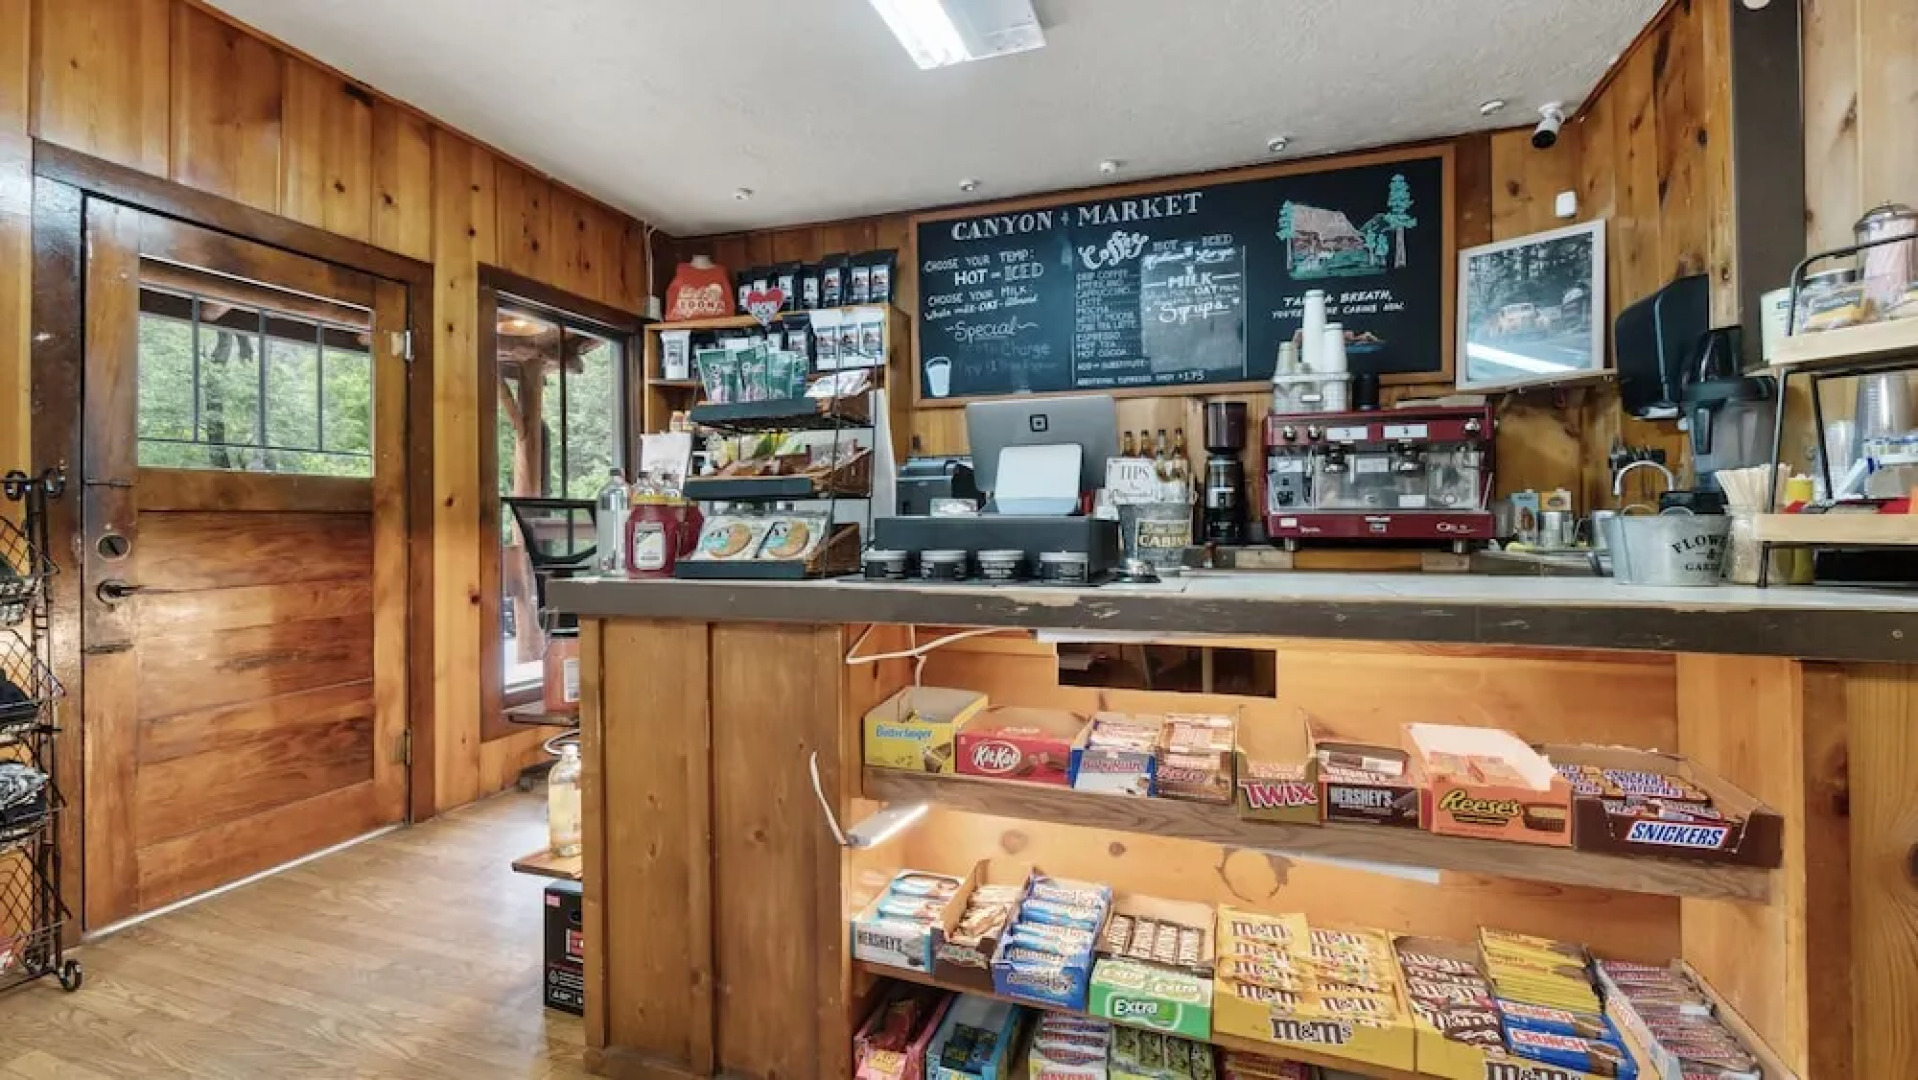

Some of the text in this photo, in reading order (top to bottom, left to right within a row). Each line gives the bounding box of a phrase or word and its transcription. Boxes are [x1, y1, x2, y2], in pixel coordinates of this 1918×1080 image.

[951, 191, 1203, 241] CANYON MARKET
[923, 257, 960, 273] CHOOSE
[964, 254, 991, 267] YOUR
[954, 262, 1045, 287] HOT ICED
[1168, 271, 1213, 289] MILK
[927, 292, 964, 307] CHOOSE
[968, 289, 994, 301] YOUR
[1330, 786, 1394, 807] HERSHEY'S
[1440, 787, 1521, 817] Reese's
[1631, 821, 1724, 847] SNICKERS
[1114, 998, 1158, 1017] Extra
[1511, 1029, 1590, 1051] CRUNCH
